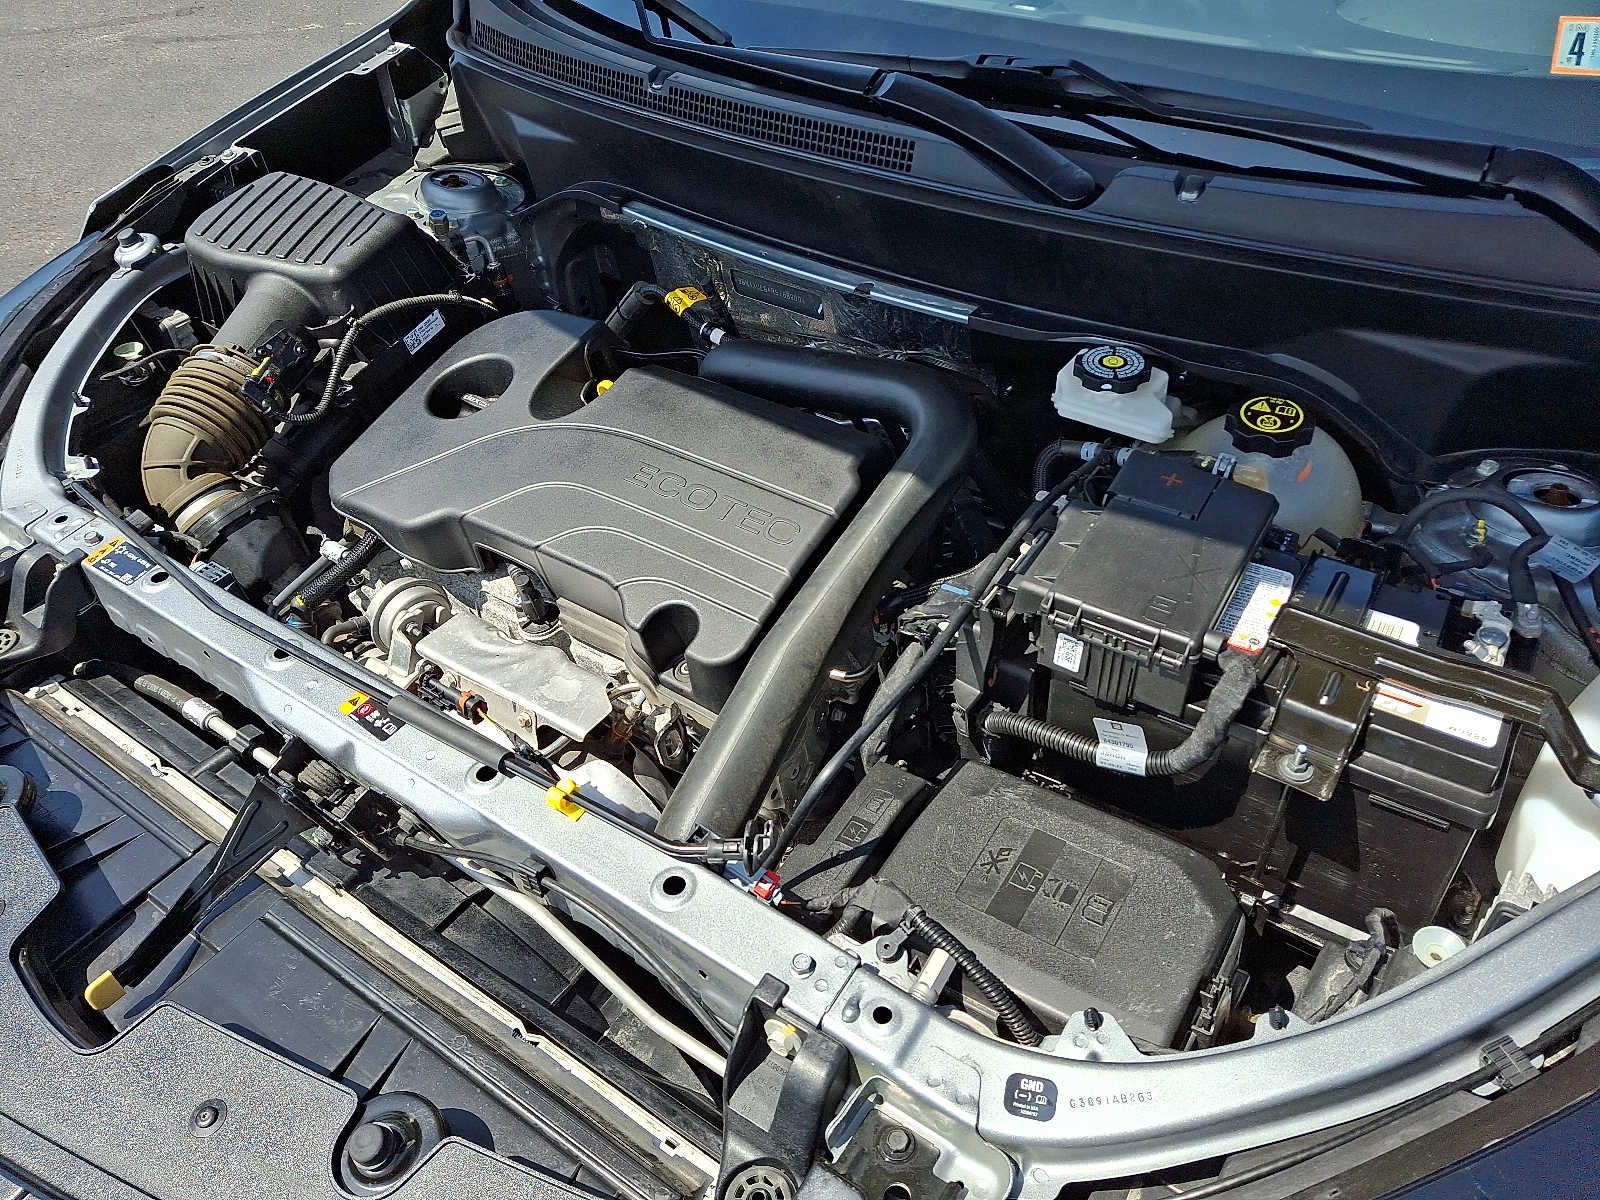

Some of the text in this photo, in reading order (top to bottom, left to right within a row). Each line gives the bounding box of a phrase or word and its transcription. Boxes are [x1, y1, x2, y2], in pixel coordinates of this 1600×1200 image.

[1568, 32, 1586, 66] 4
[623, 459, 801, 545] ECOTEC
[1020, 1078, 1044, 1093] GND
